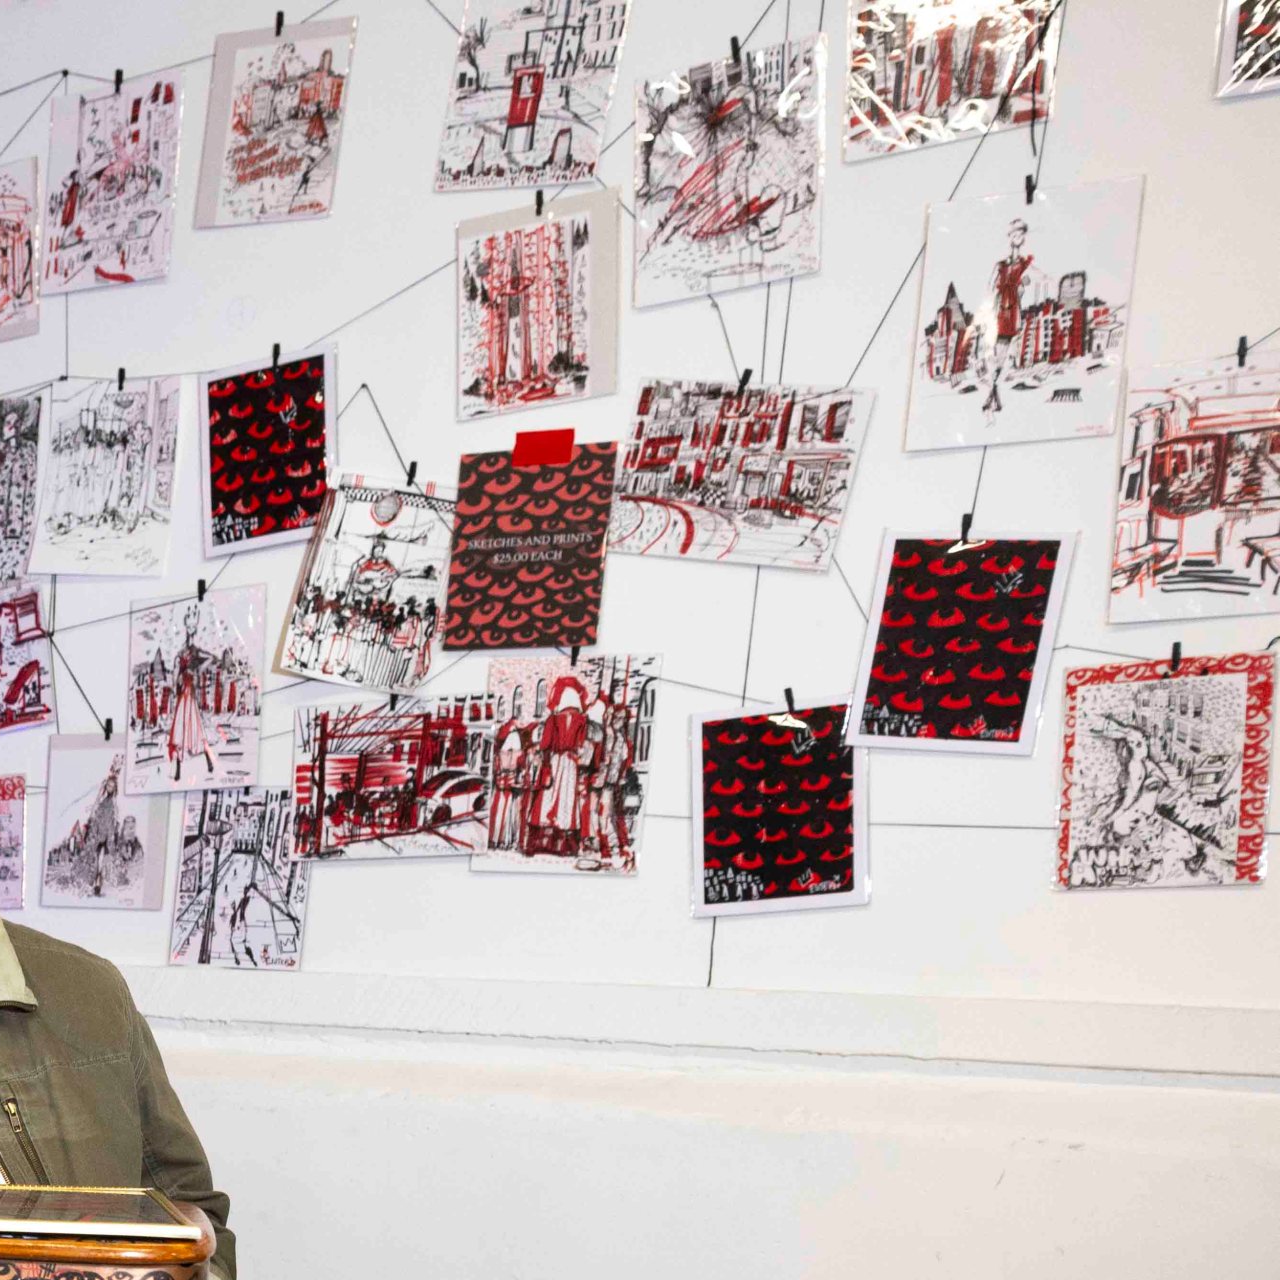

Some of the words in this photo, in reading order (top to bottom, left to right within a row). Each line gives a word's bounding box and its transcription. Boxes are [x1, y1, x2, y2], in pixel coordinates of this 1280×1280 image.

[467, 536, 523, 550] SKETCHES
[524, 534, 551, 547] AND
[552, 532, 593, 545] PRINTS
[493, 552, 529, 564] $25.00
[530, 550, 563, 561] EACH
